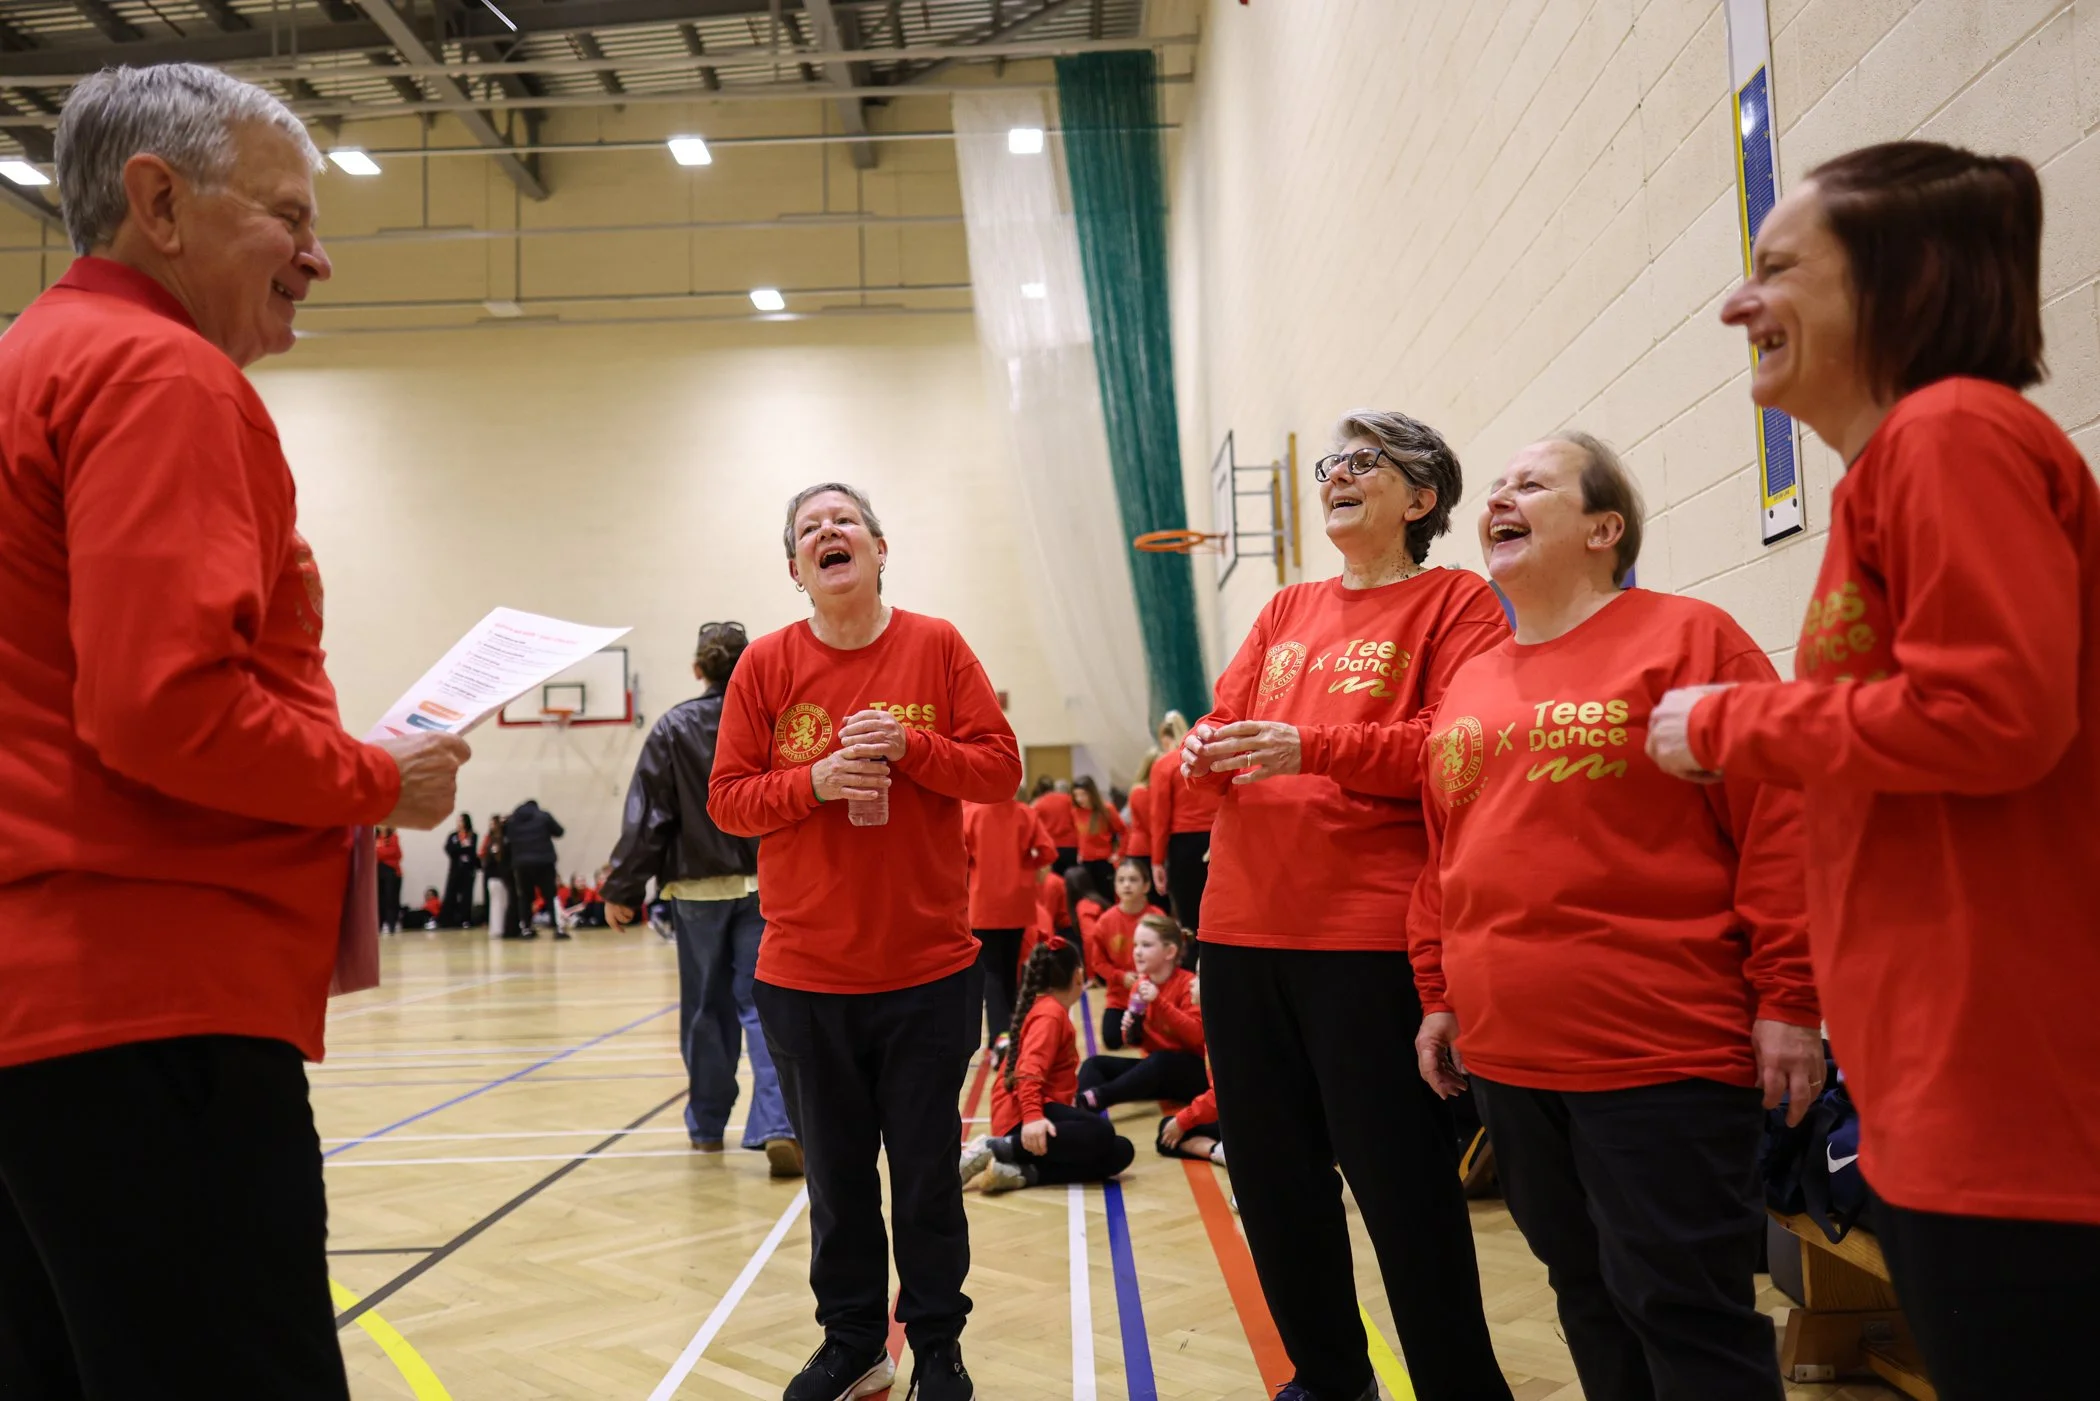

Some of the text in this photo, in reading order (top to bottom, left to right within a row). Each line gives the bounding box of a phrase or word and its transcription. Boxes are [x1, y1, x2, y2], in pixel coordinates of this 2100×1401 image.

[1805, 582, 1865, 636] ees
[1344, 639, 1410, 669] Tees
[1333, 657, 1403, 683] Dance
[869, 701, 937, 723] Tees
[1534, 699, 1629, 728] Tees
[1528, 725, 1629, 752] Dance
